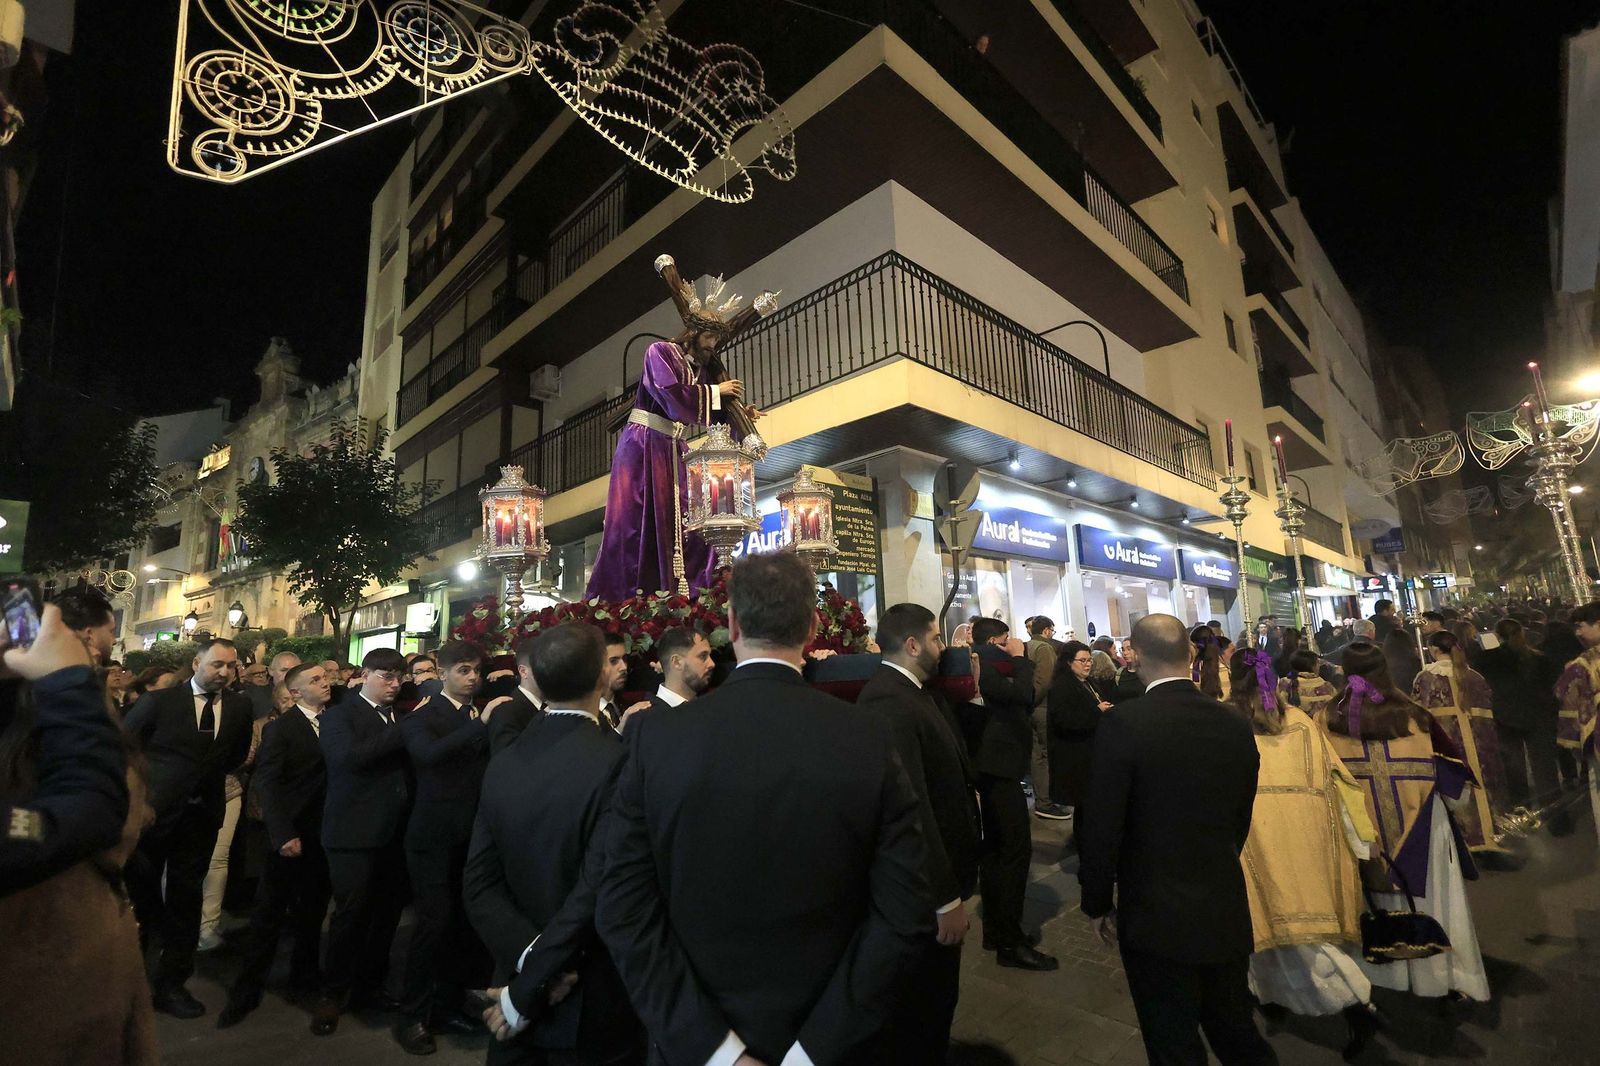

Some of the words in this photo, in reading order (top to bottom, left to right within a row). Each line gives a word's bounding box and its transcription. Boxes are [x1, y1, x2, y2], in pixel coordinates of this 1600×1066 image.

[843, 490, 858, 499] Plaza
[835, 503, 873, 515] ayuntamiento
[982, 511, 1020, 543] Aural
[747, 529, 791, 554] Aura
[860, 538, 875, 546] Europa
[1116, 541, 1139, 565] Aural
